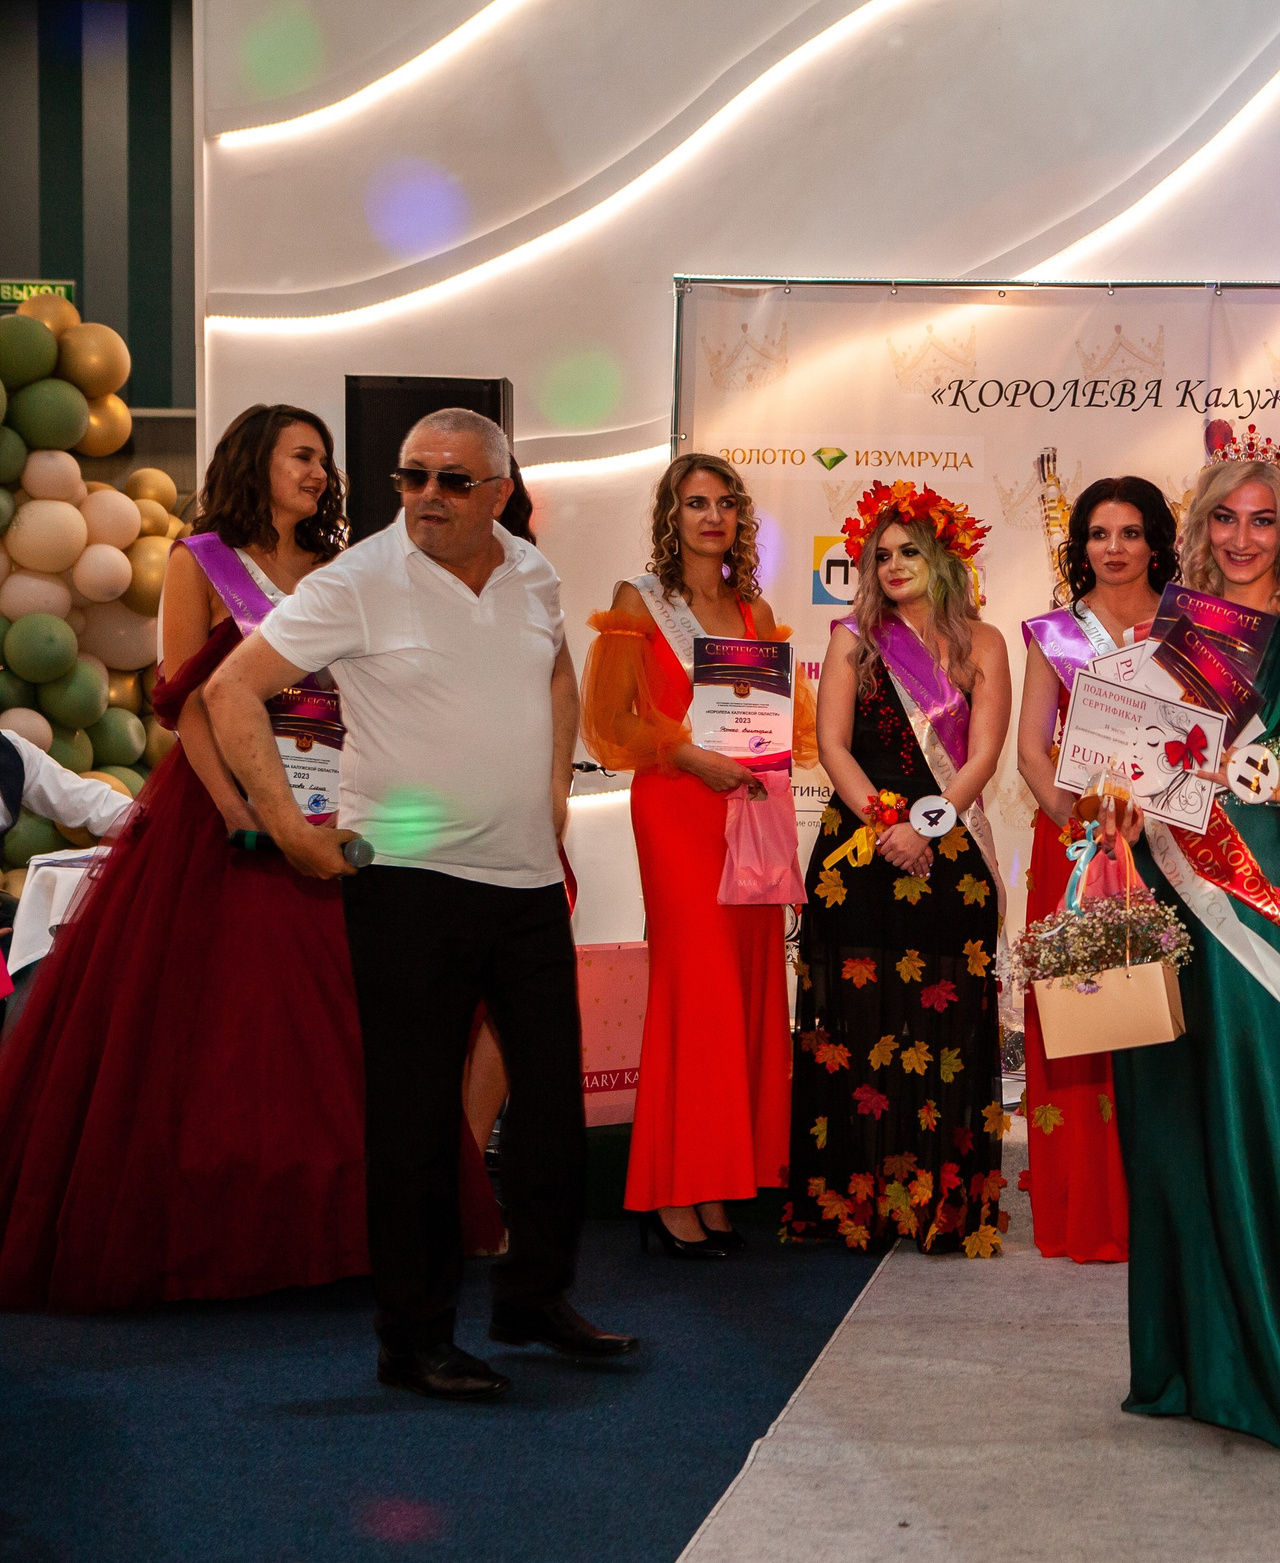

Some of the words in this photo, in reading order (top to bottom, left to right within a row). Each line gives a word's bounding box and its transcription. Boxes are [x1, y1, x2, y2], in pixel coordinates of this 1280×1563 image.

[931, 378, 1163, 414] «КОРОЛЕВА
[720, 447, 806, 467] ЗОЛОТО
[854, 450, 974, 472] ИЗУМРУДА
[648, 589, 694, 660] КОРОЛЕВ
[1175, 593, 1262, 632] CERTIFICATE
[704, 642, 779, 659] CERTIFICATE
[1184, 629, 1252, 705] CERTIFICATE
[272, 693, 340, 711] CERTIFICAT
[1083, 683, 1147, 711] ПОДАРОЧНЫЙ
[1082, 697, 1144, 724] СЕРТИФИКАТ
[293, 771, 310, 780] 2023
[922, 807, 947, 828] 4
[624, 1071, 640, 1085] KA
